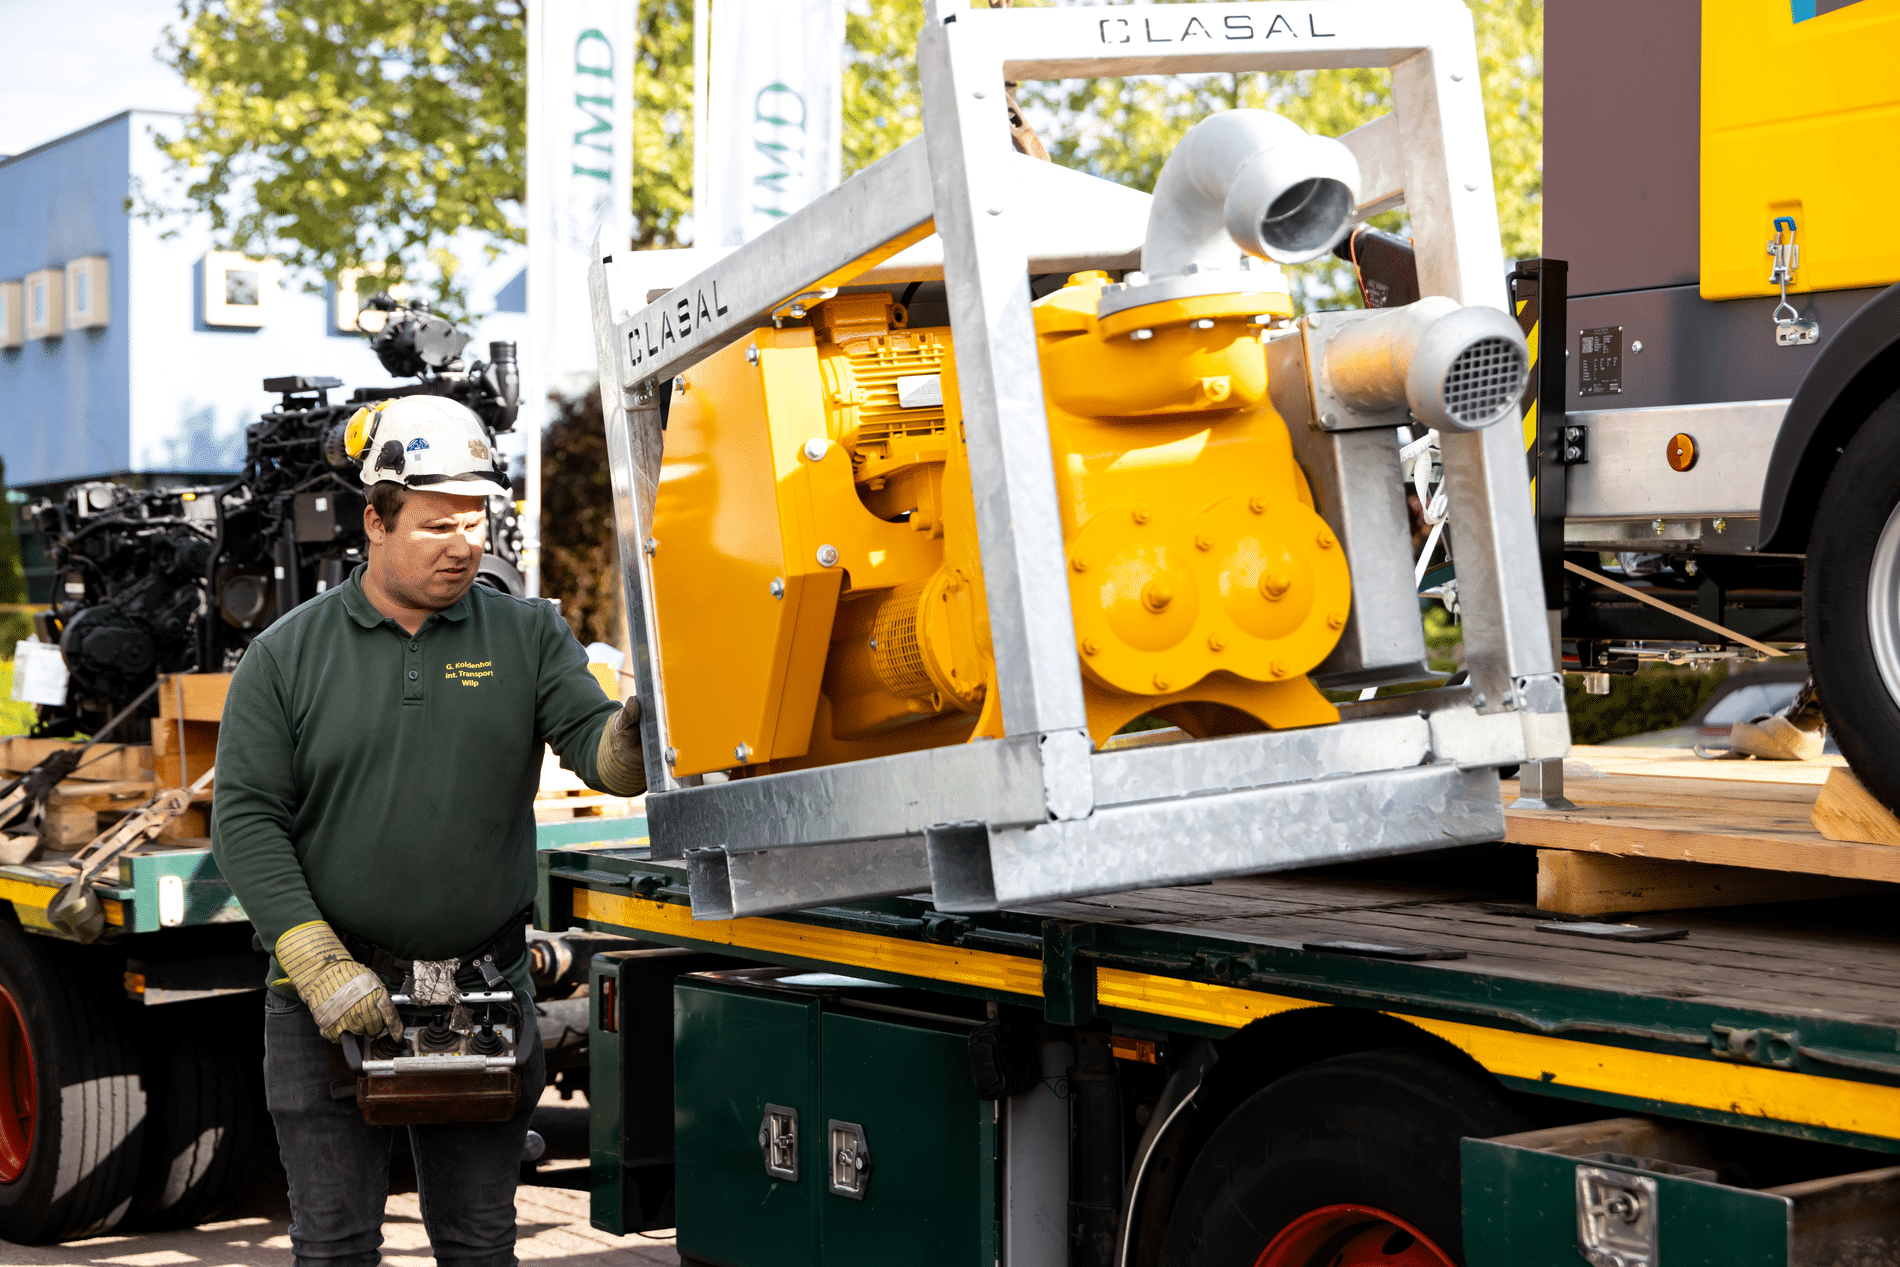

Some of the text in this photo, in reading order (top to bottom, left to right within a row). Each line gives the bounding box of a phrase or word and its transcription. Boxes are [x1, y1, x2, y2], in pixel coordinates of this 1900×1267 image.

[1099, 14, 1335, 43] CLASAL
[573, 29, 613, 182] IMD
[754, 83, 805, 217] IMD
[628, 280, 728, 366] CLASAL
[458, 670, 493, 678] Transport
[461, 679, 479, 687] Wilp
